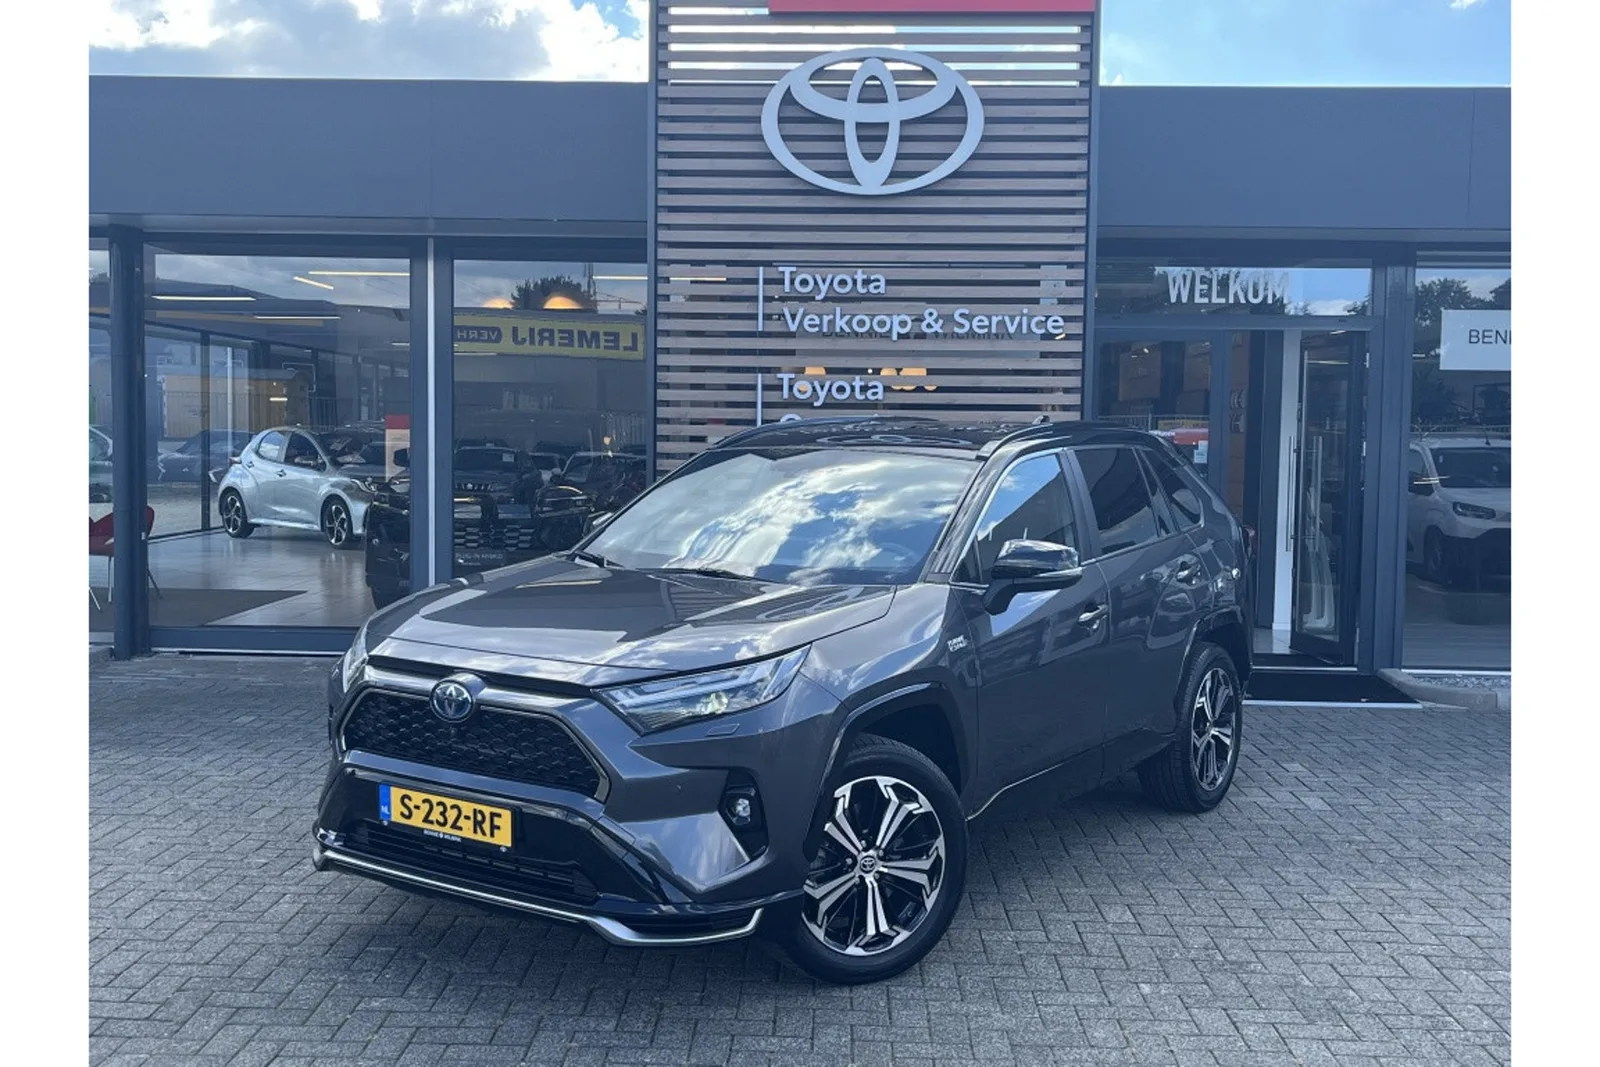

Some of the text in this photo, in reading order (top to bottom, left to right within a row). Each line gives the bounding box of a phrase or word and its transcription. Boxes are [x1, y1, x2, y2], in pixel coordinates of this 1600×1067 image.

[777, 266, 886, 300] Toyota
[1167, 270, 1289, 304] WELKOM
[782, 307, 1065, 340] Verkoop & Service
[777, 373, 884, 407] Toyota
[381, 805, 391, 815] NL
[400, 794, 502, 838] S-232-RF
